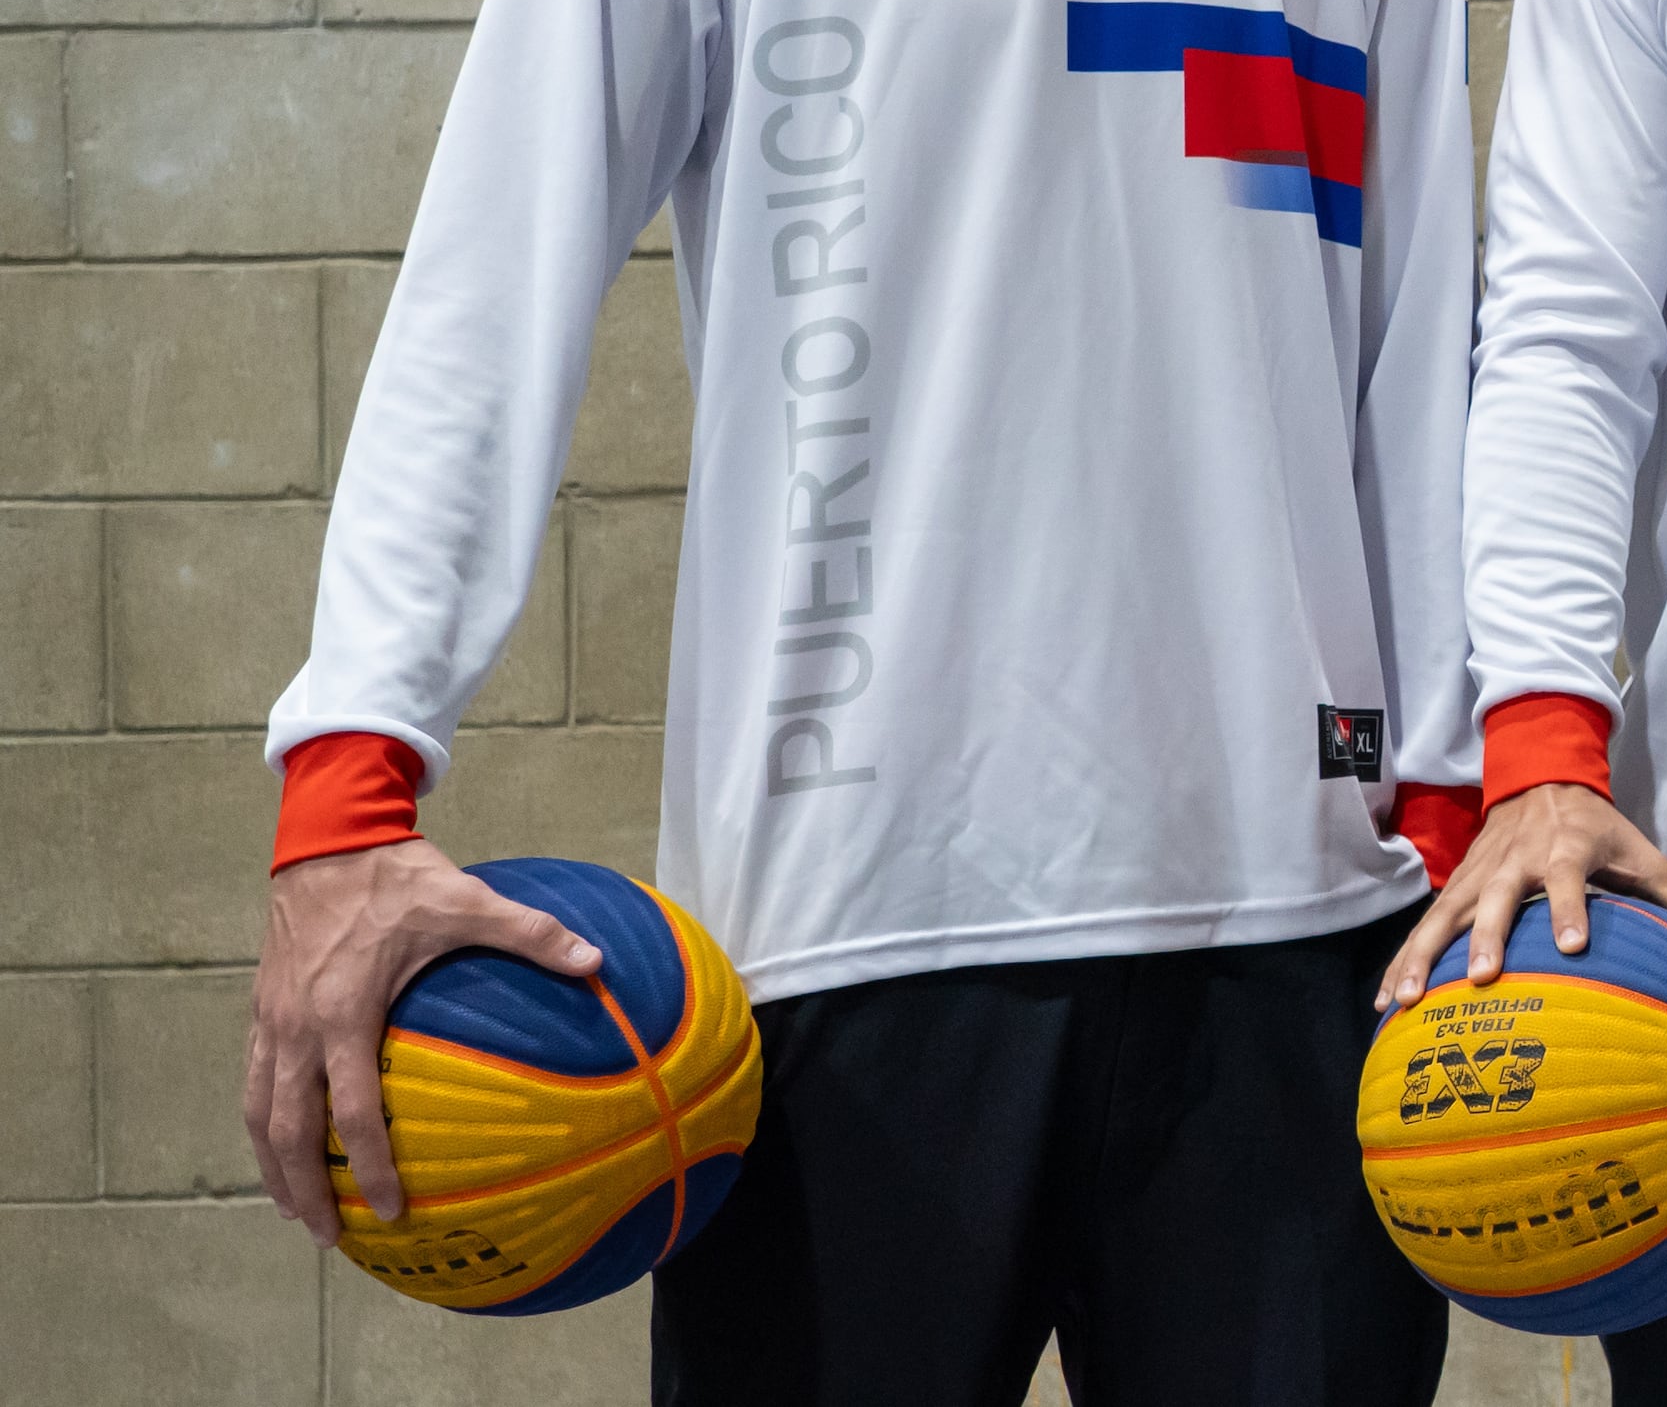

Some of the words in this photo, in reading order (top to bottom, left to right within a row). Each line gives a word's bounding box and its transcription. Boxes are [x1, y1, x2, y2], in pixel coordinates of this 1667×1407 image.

[753, 16, 868, 297] RICO
[767, 316, 877, 798] PUERTO
[1356, 732, 1374, 753] XL
[1423, 1004, 1457, 1025] BALL
[1461, 998, 1544, 1018] OFFICIAL
[1435, 1021, 1468, 1039] 3x3
[1472, 1017, 1515, 1034] FIBA
